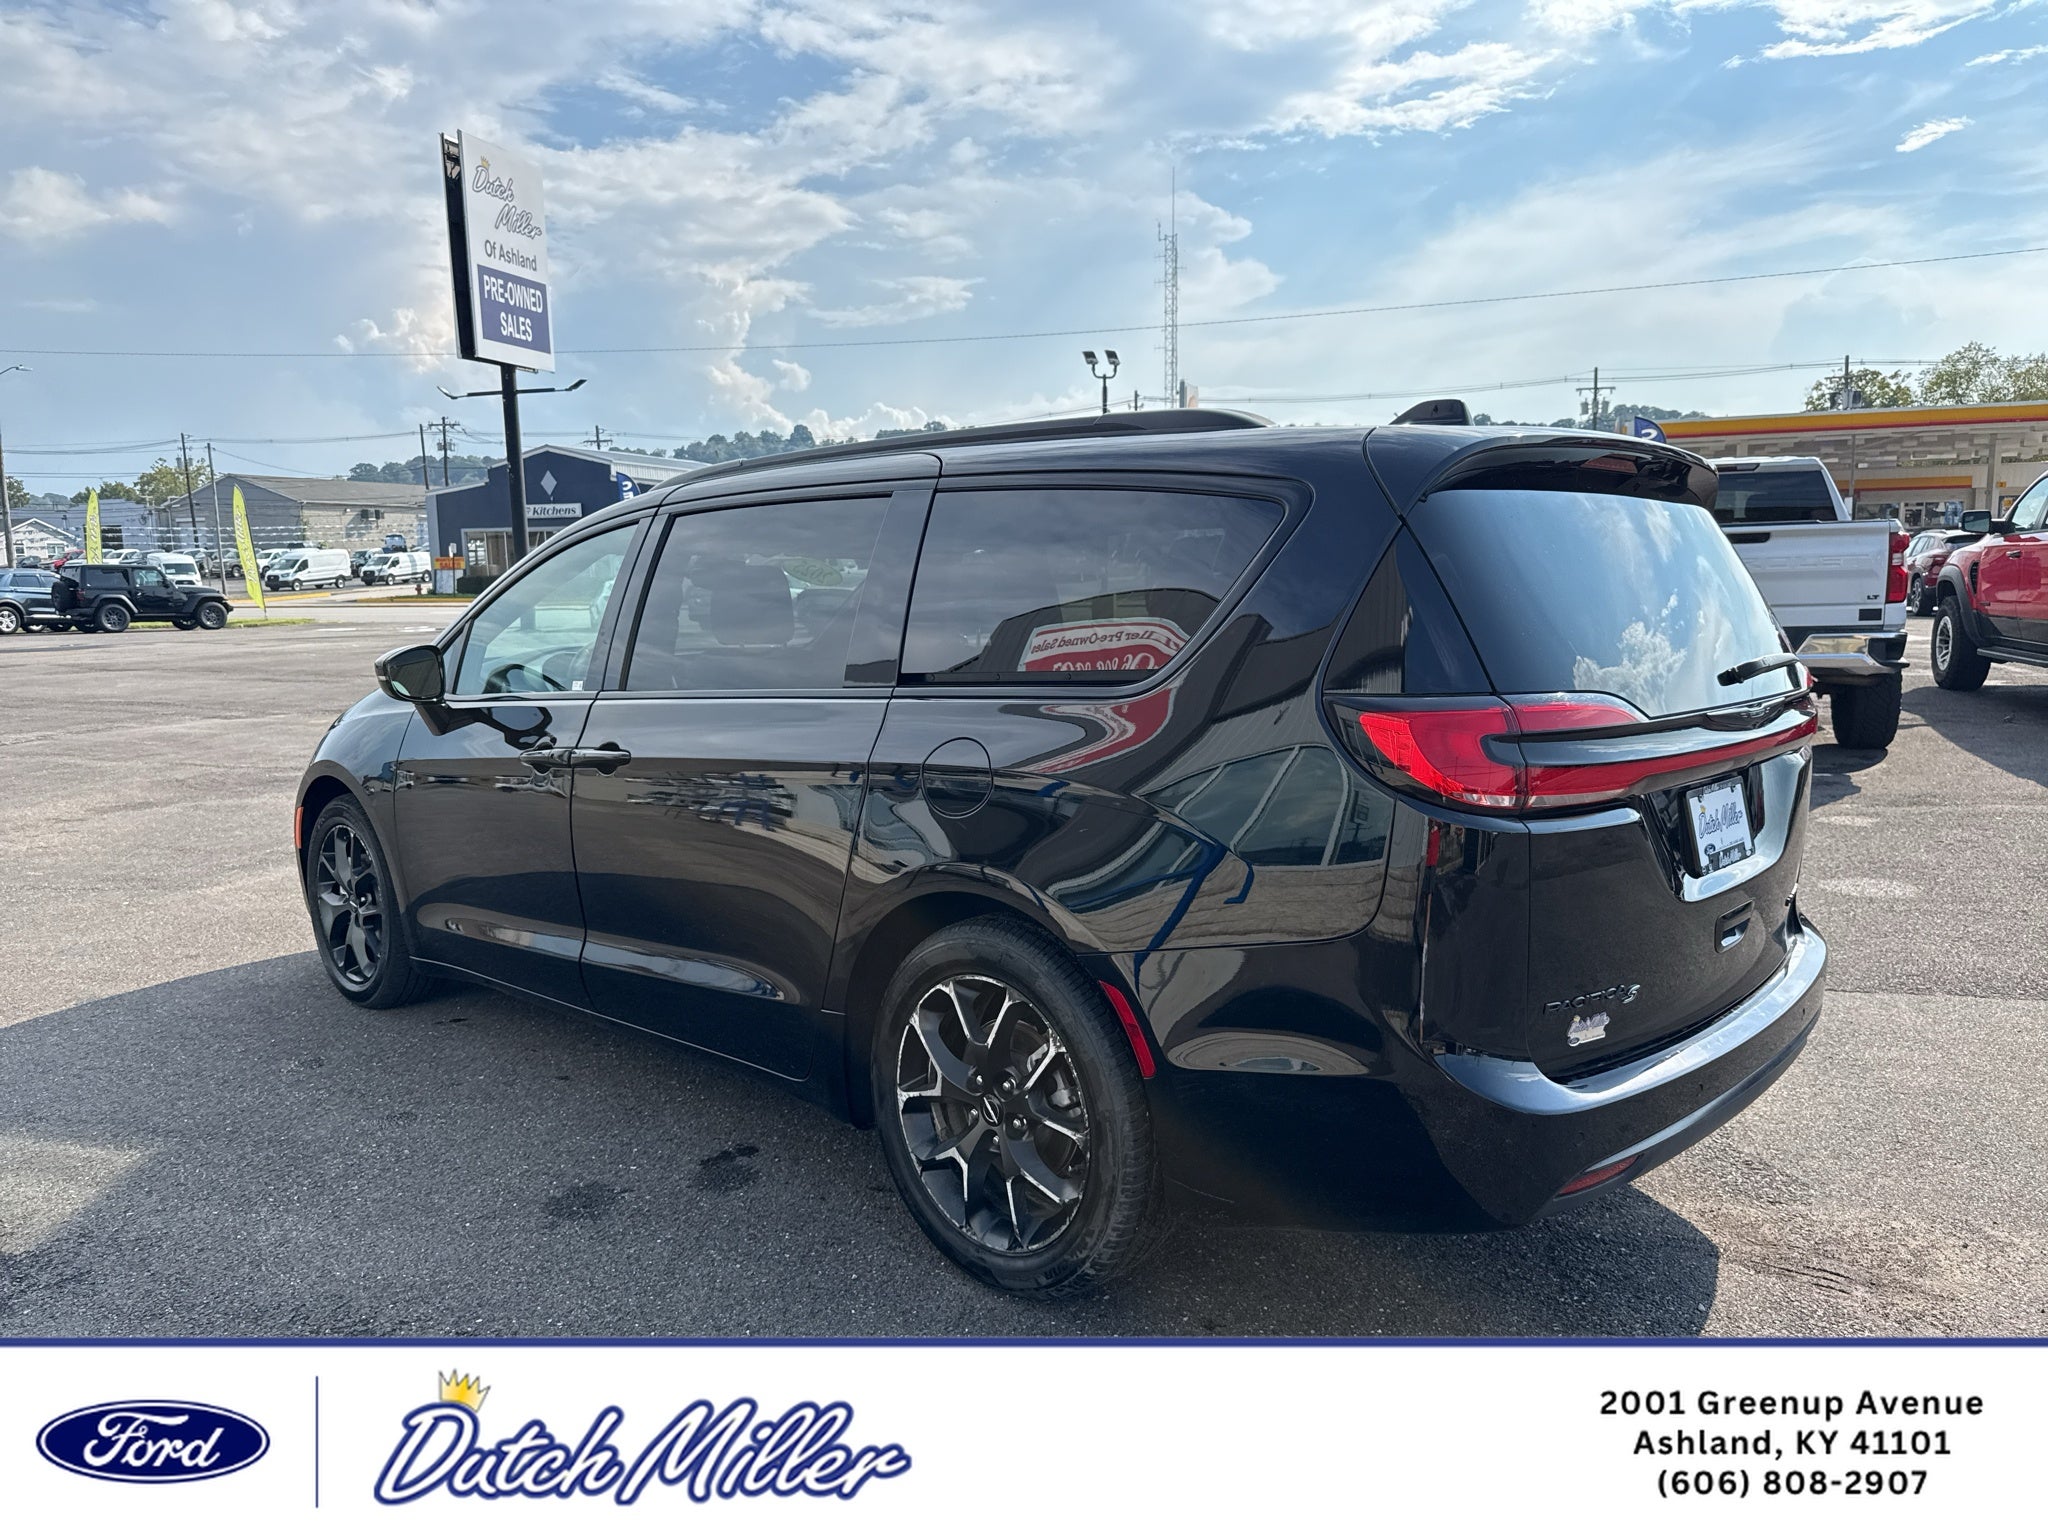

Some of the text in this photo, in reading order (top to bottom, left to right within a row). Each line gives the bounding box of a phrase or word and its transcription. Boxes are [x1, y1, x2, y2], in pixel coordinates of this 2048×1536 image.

[472, 164, 514, 203] Dutch
[495, 203, 543, 239] Miller
[484, 239, 537, 272] Of Ashland
[483, 273, 543, 314] PRE-OWNED
[500, 311, 533, 342] SALES
[532, 506, 577, 516] Kitchens
